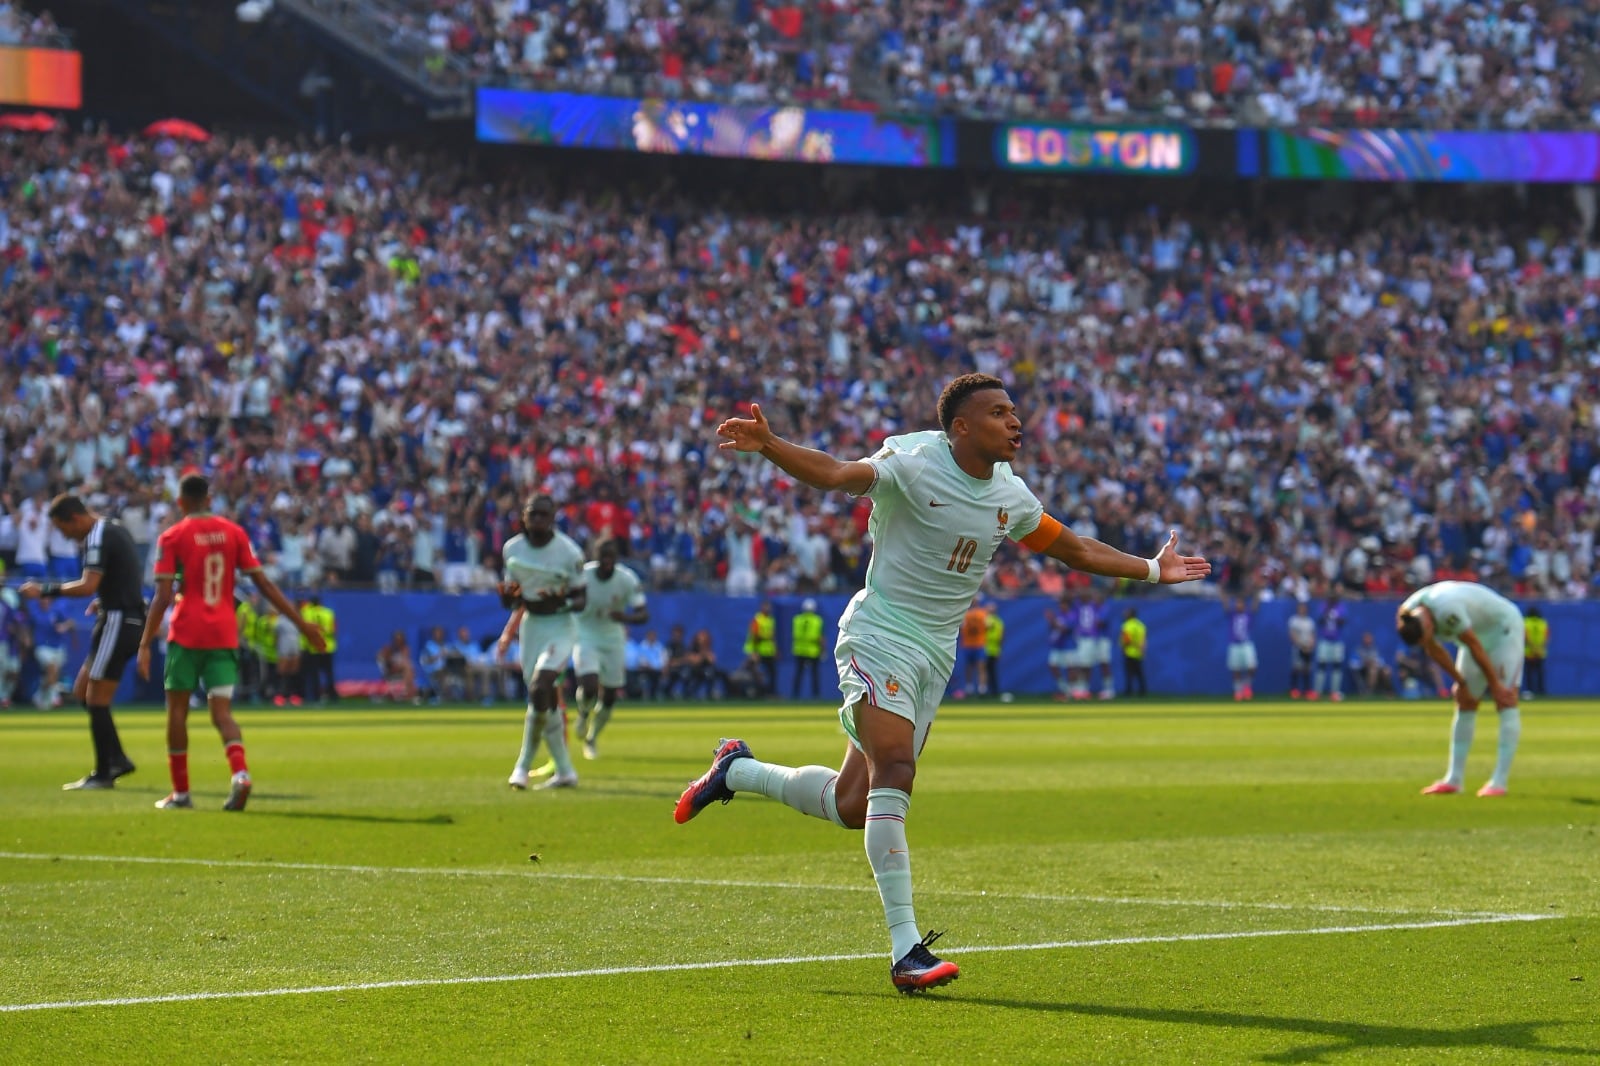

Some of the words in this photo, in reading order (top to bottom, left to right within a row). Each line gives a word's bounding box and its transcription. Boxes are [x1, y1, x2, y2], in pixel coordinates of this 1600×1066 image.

[1008, 127, 1182, 169] BOSTON
[946, 537, 978, 574] 10
[204, 552, 225, 607] 8
